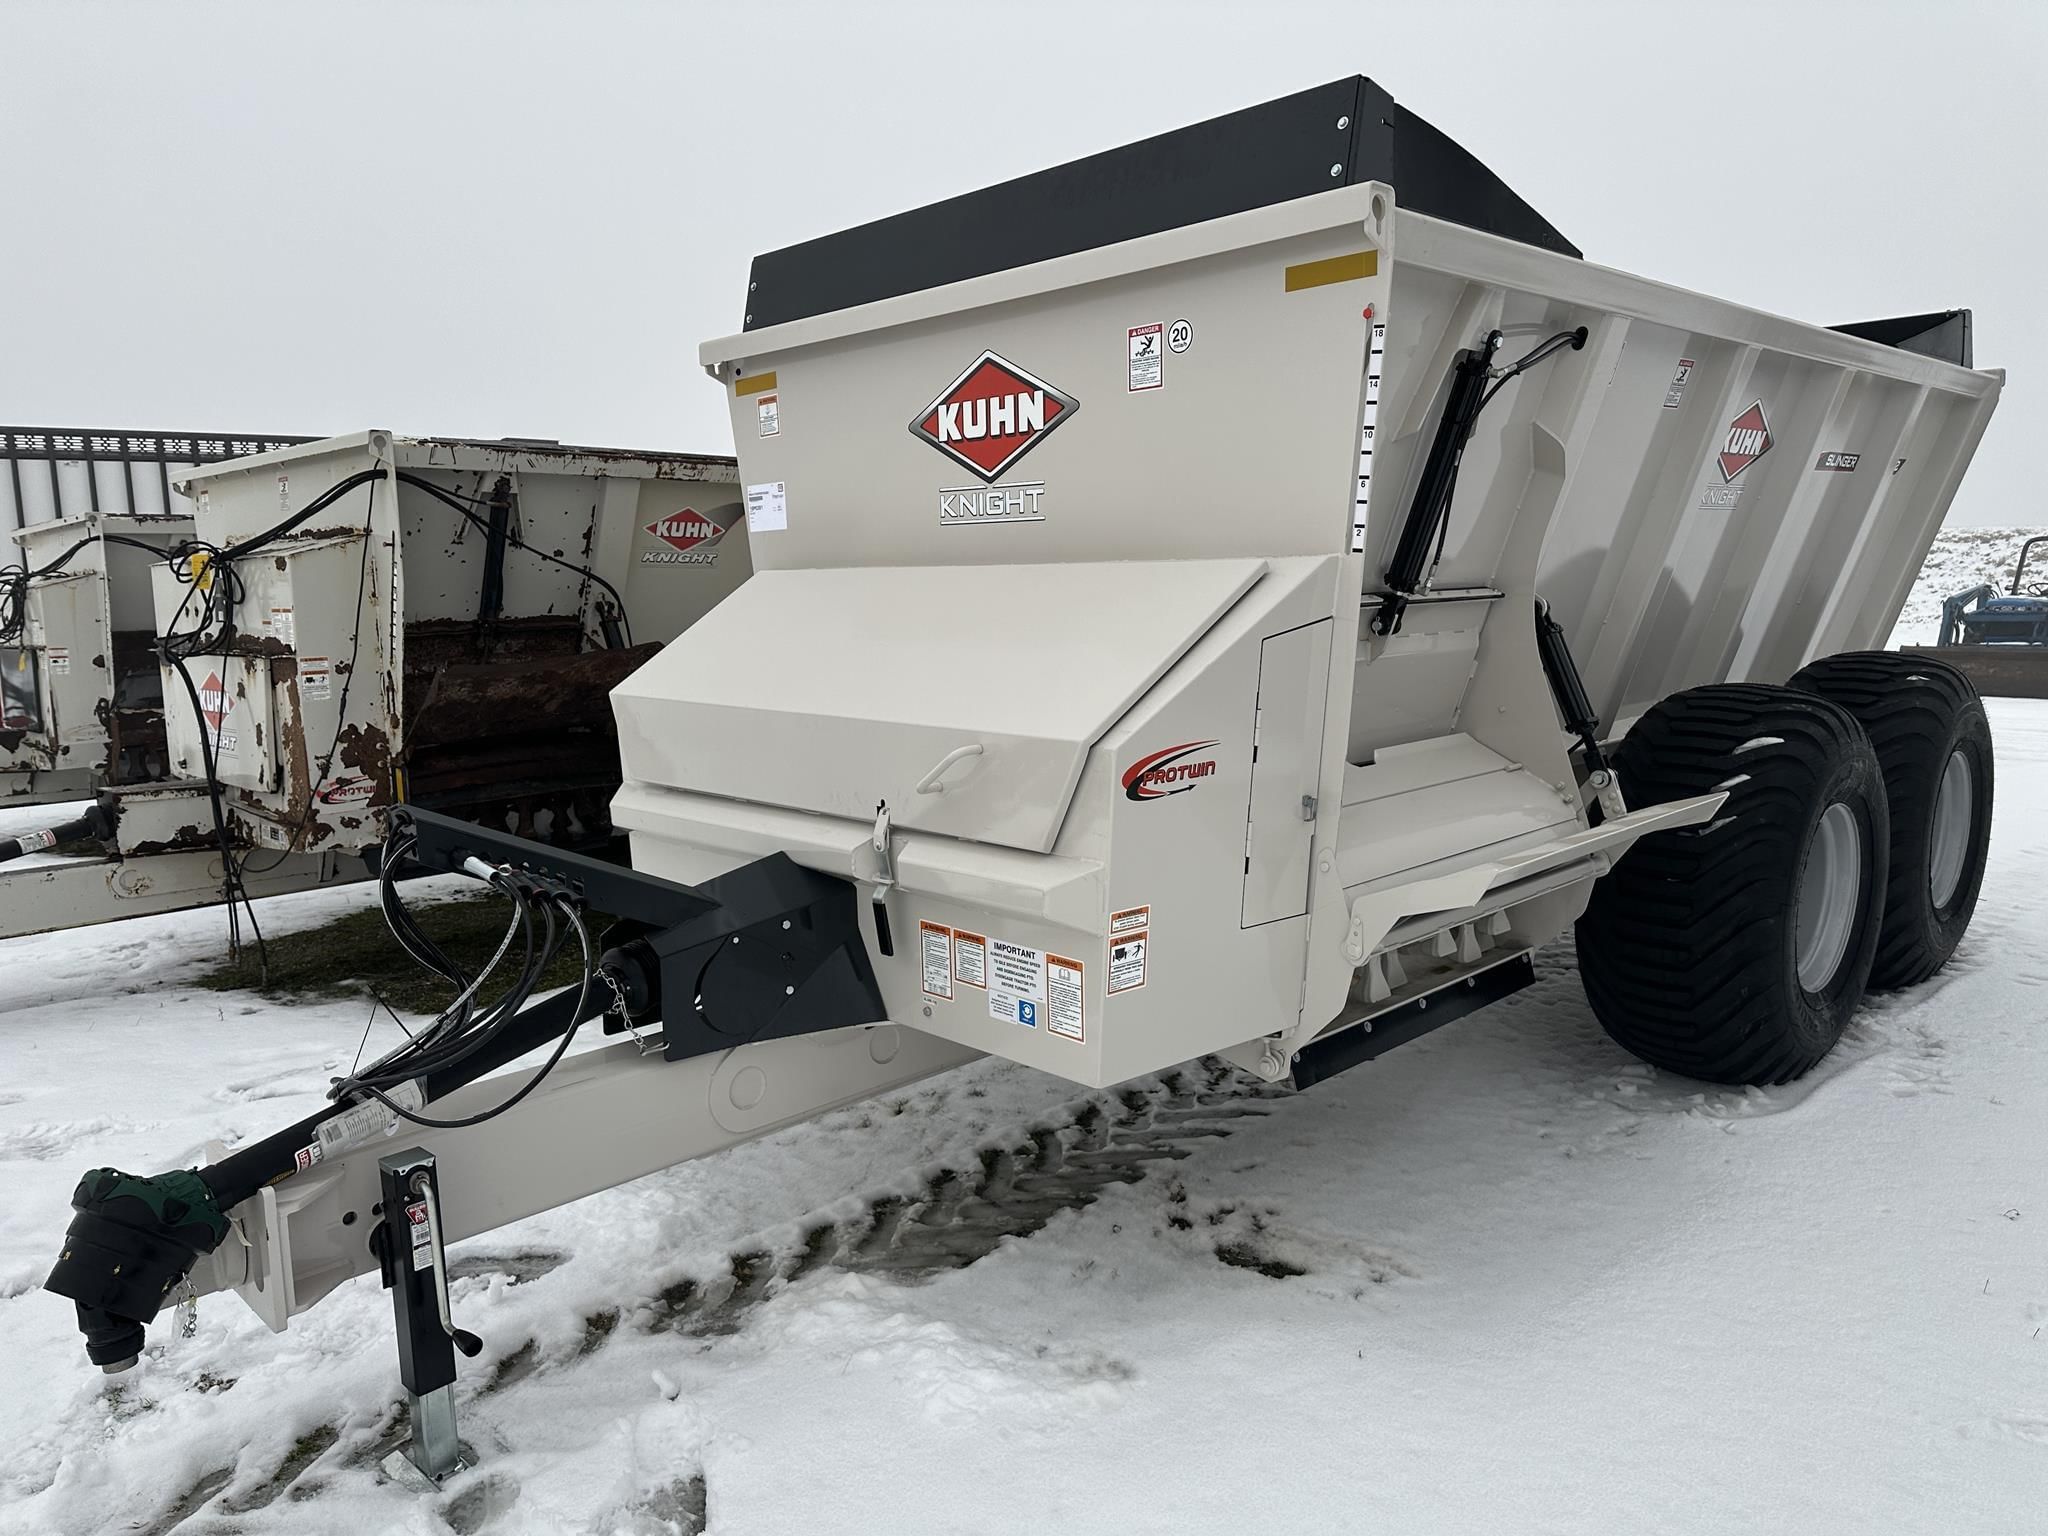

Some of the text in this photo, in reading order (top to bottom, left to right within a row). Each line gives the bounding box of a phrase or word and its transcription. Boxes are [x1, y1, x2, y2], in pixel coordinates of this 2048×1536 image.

[1137, 325, 1160, 336] DANGER
[1172, 326, 1188, 343] 20
[1374, 329, 1384, 338] 18
[1369, 380, 1378, 388] 14
[937, 389, 1045, 443] KUHN
[1364, 430, 1373, 439] 10
[1723, 427, 1767, 456] KUHN
[1825, 453, 1858, 468] SLINGER
[1360, 480, 1366, 488] 6
[940, 488, 1045, 518] KNIGHT
[1701, 487, 1744, 506] KNIGHT
[656, 521, 714, 538] KUHN
[1356, 528, 1362, 537] 2
[641, 551, 718, 565] KNIGHT
[199, 689, 230, 714] KUHN
[1142, 760, 1216, 786] PROTWIN
[994, 942, 1036, 959] IMPORTANT
